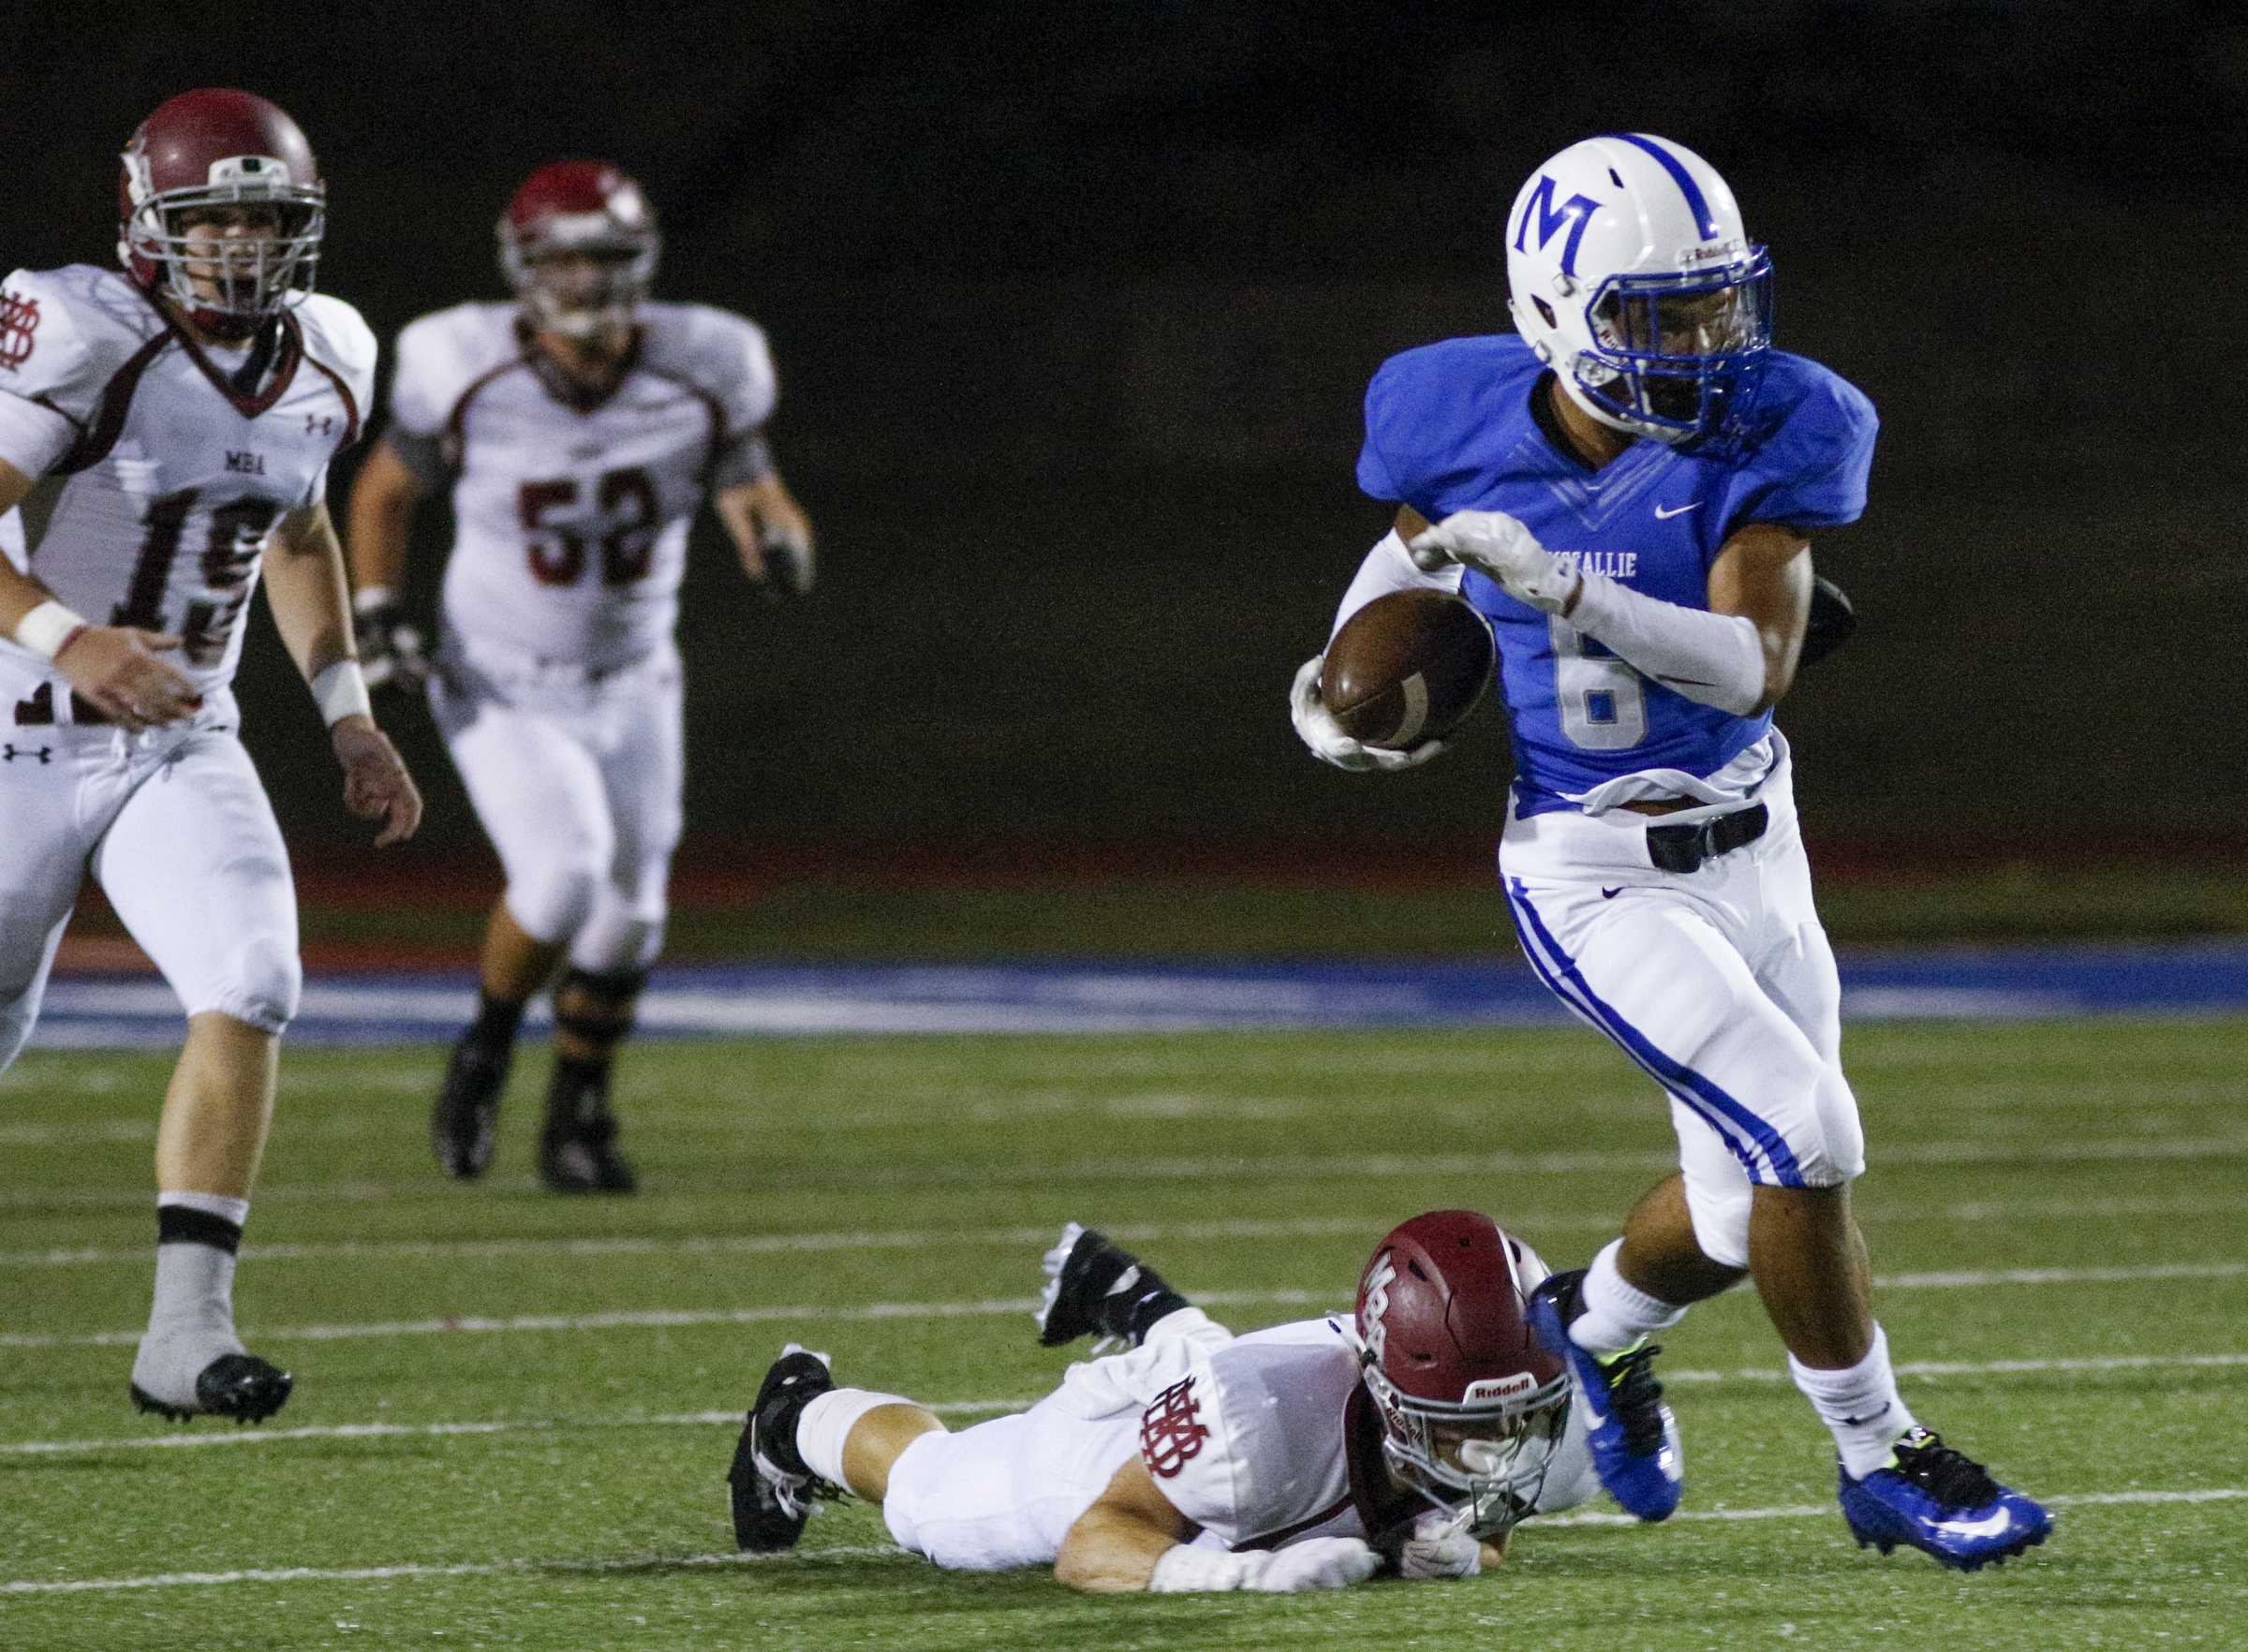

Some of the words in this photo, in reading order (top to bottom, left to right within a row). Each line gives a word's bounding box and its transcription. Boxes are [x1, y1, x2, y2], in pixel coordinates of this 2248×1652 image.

[1514, 173, 1606, 278] M
[518, 468, 655, 587] 52
[1550, 613, 1648, 750] 6
[1474, 1378, 1530, 1399] Riddell
